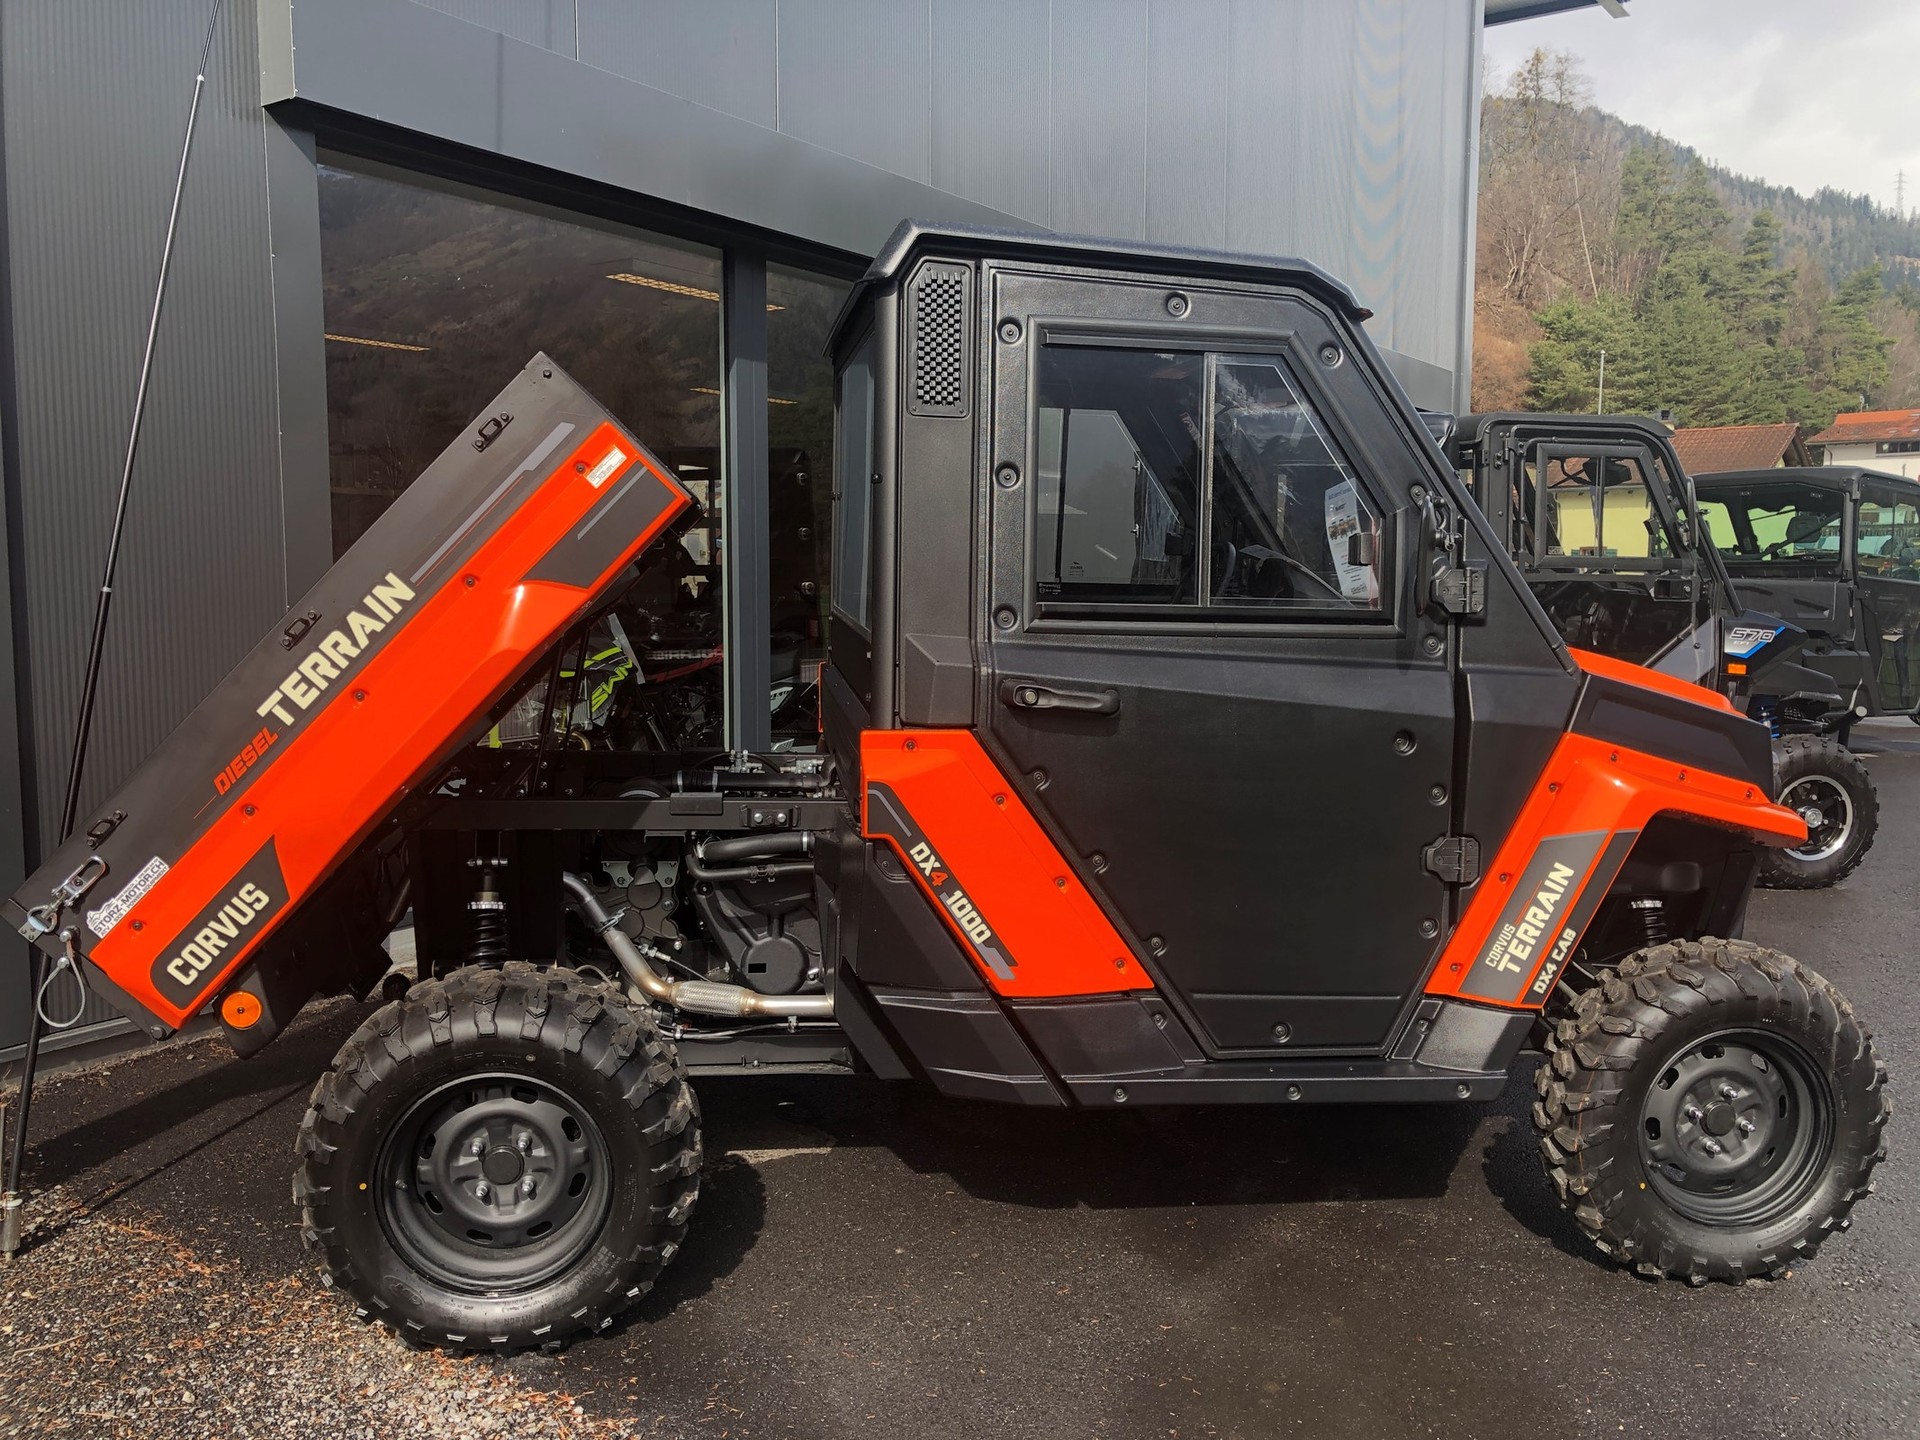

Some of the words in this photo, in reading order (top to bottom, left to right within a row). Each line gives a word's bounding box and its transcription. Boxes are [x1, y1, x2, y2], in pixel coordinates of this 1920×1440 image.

[256, 572, 416, 726] TERRAIN
[1729, 627, 1776, 642] 570
[213, 727, 279, 796] DIESEL
[92, 859, 165, 934] STORZ-MOTOR.CH
[126, 891, 143, 909] POWER
[909, 841, 949, 887] DX4
[946, 890, 992, 945] 1000
[1496, 862, 1575, 973] TERRAIN
[166, 883, 269, 986] CORVUS
[1485, 923, 1516, 968] CORVUS
[1533, 962, 1557, 994] DX4
[1551, 927, 1577, 962] CAB
